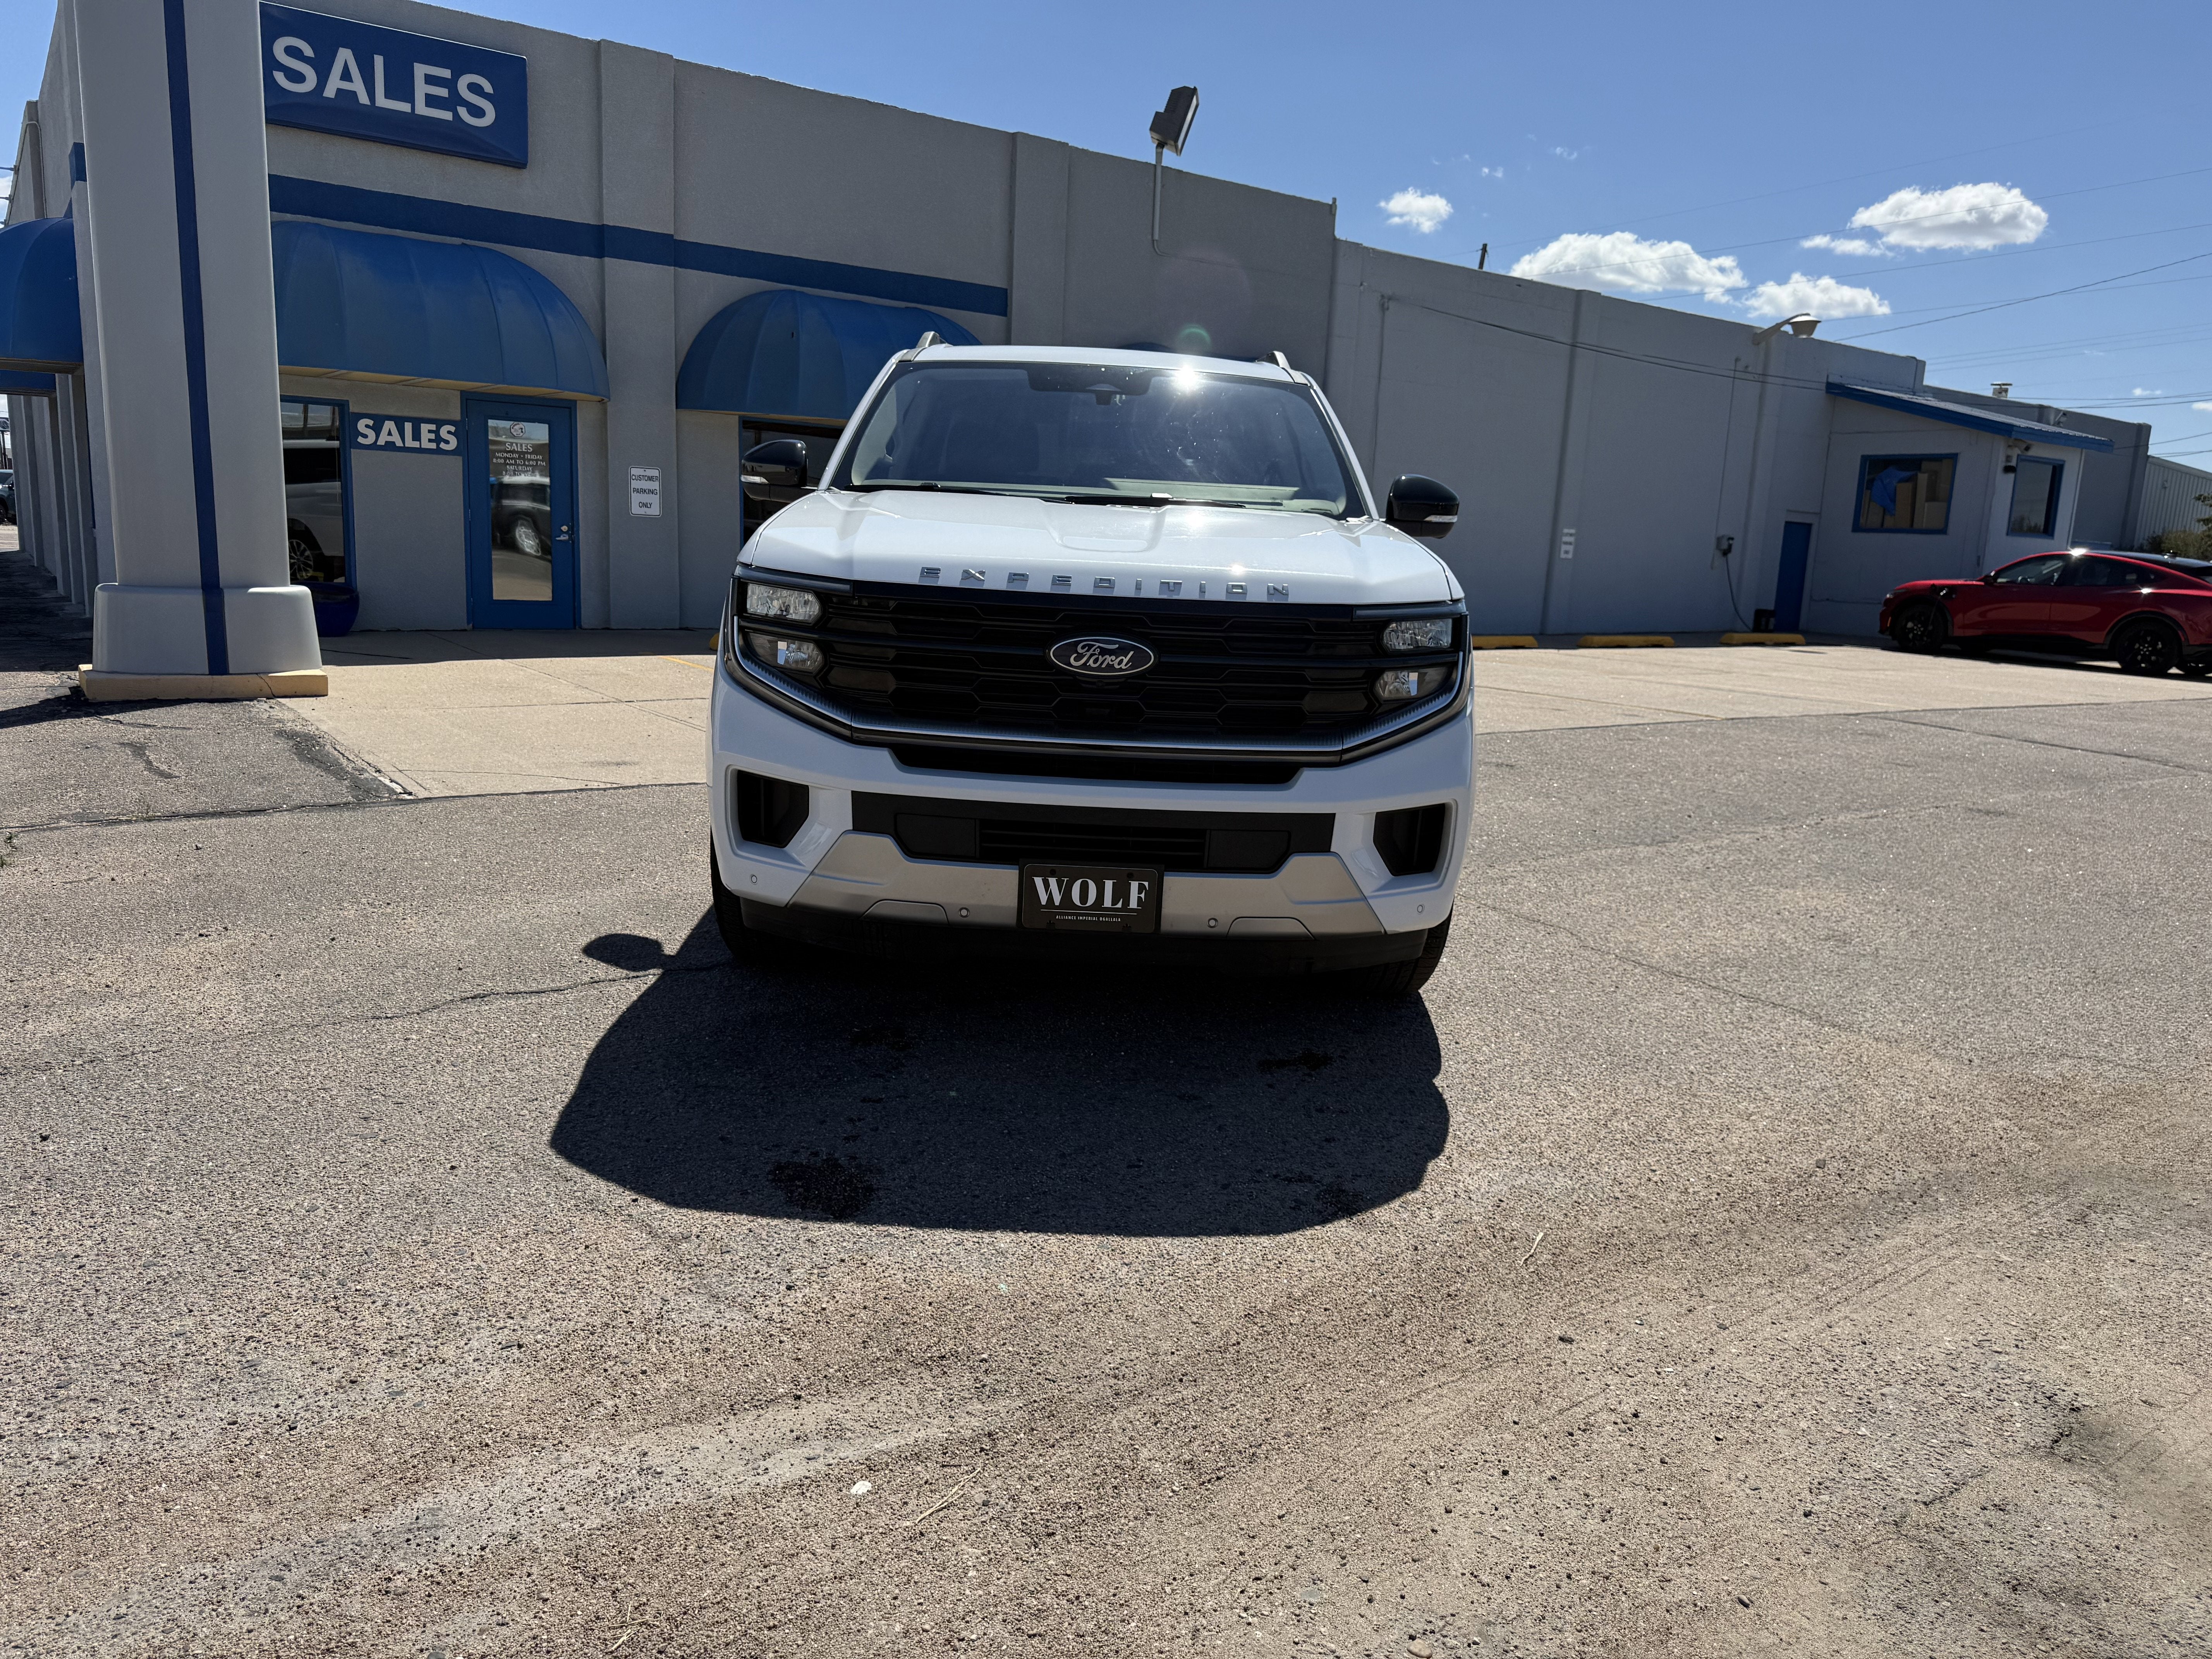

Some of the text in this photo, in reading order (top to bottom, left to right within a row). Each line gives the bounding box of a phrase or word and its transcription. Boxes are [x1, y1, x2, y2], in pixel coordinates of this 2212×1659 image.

[273, 36, 496, 127] SALES
[357, 418, 457, 450] SALES
[506, 443, 532, 452] SALES
[919, 567, 1289, 596] EXPEDITION
[1070, 642, 1134, 669] Ford
[1032, 877, 1149, 908] WOLF
